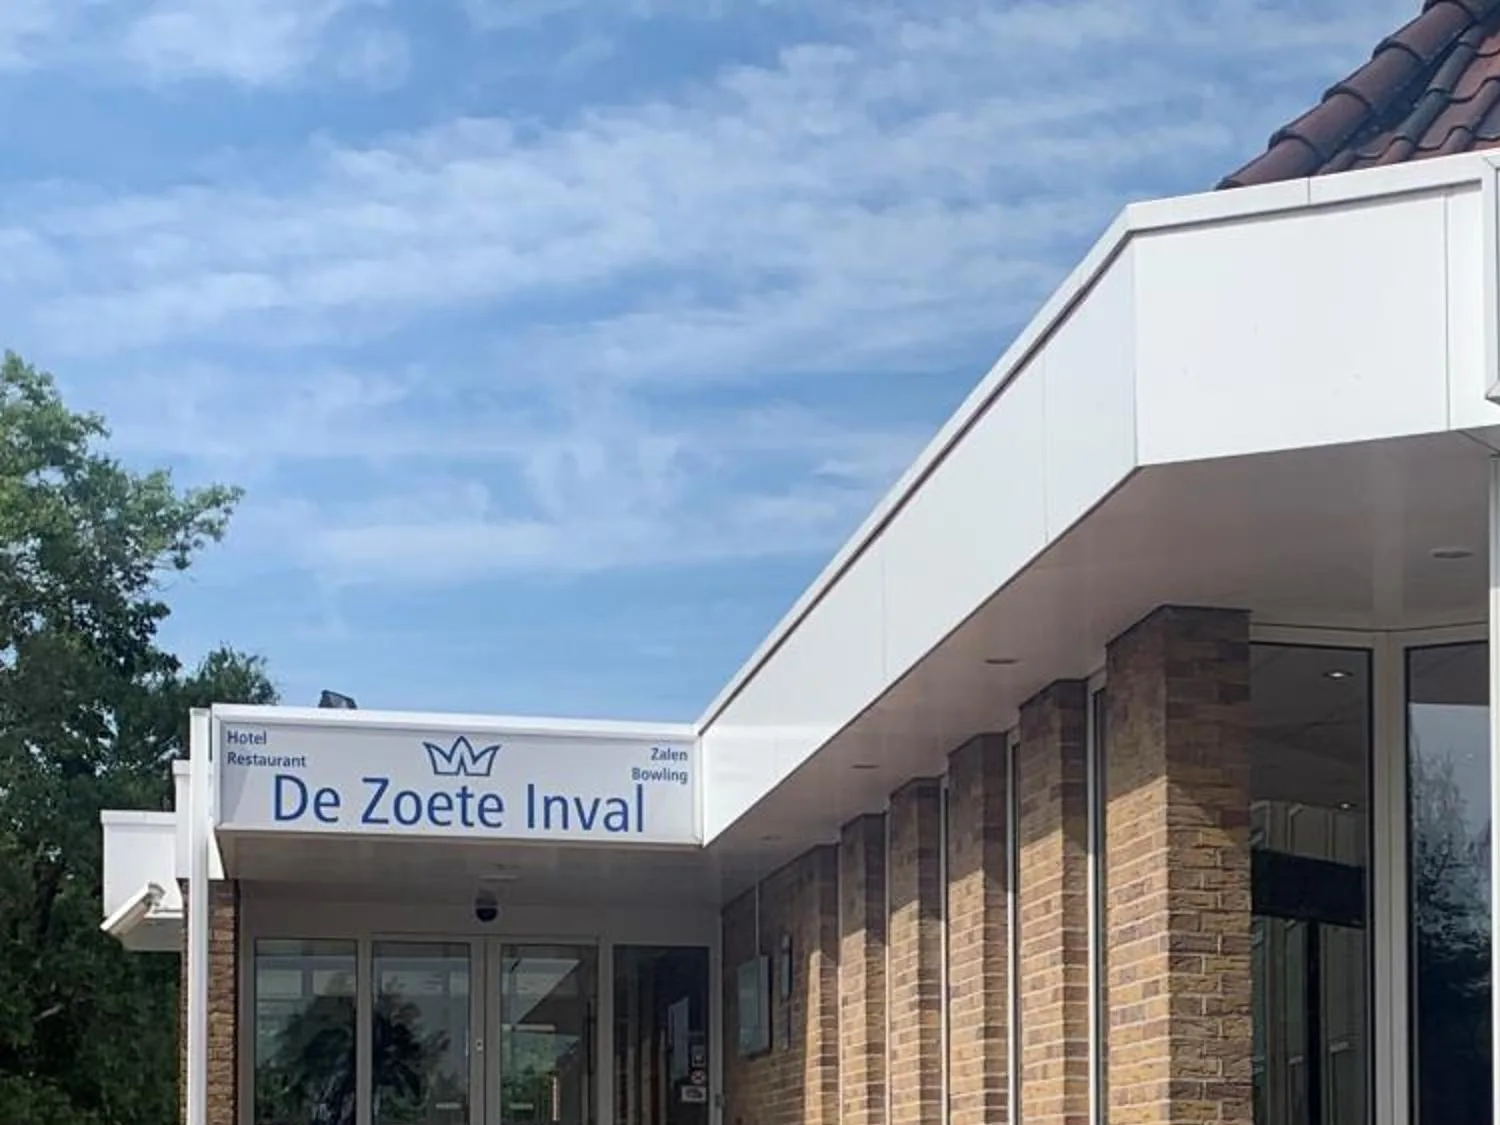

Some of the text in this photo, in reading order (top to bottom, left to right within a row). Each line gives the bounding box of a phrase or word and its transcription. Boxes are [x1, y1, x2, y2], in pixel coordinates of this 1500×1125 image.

[226, 729, 268, 745] Hotel
[226, 751, 306, 768] Restaurant
[650, 747, 688, 761] Zalen
[631, 767, 688, 785] Bowling
[272, 773, 646, 833] De Zoete Inval
